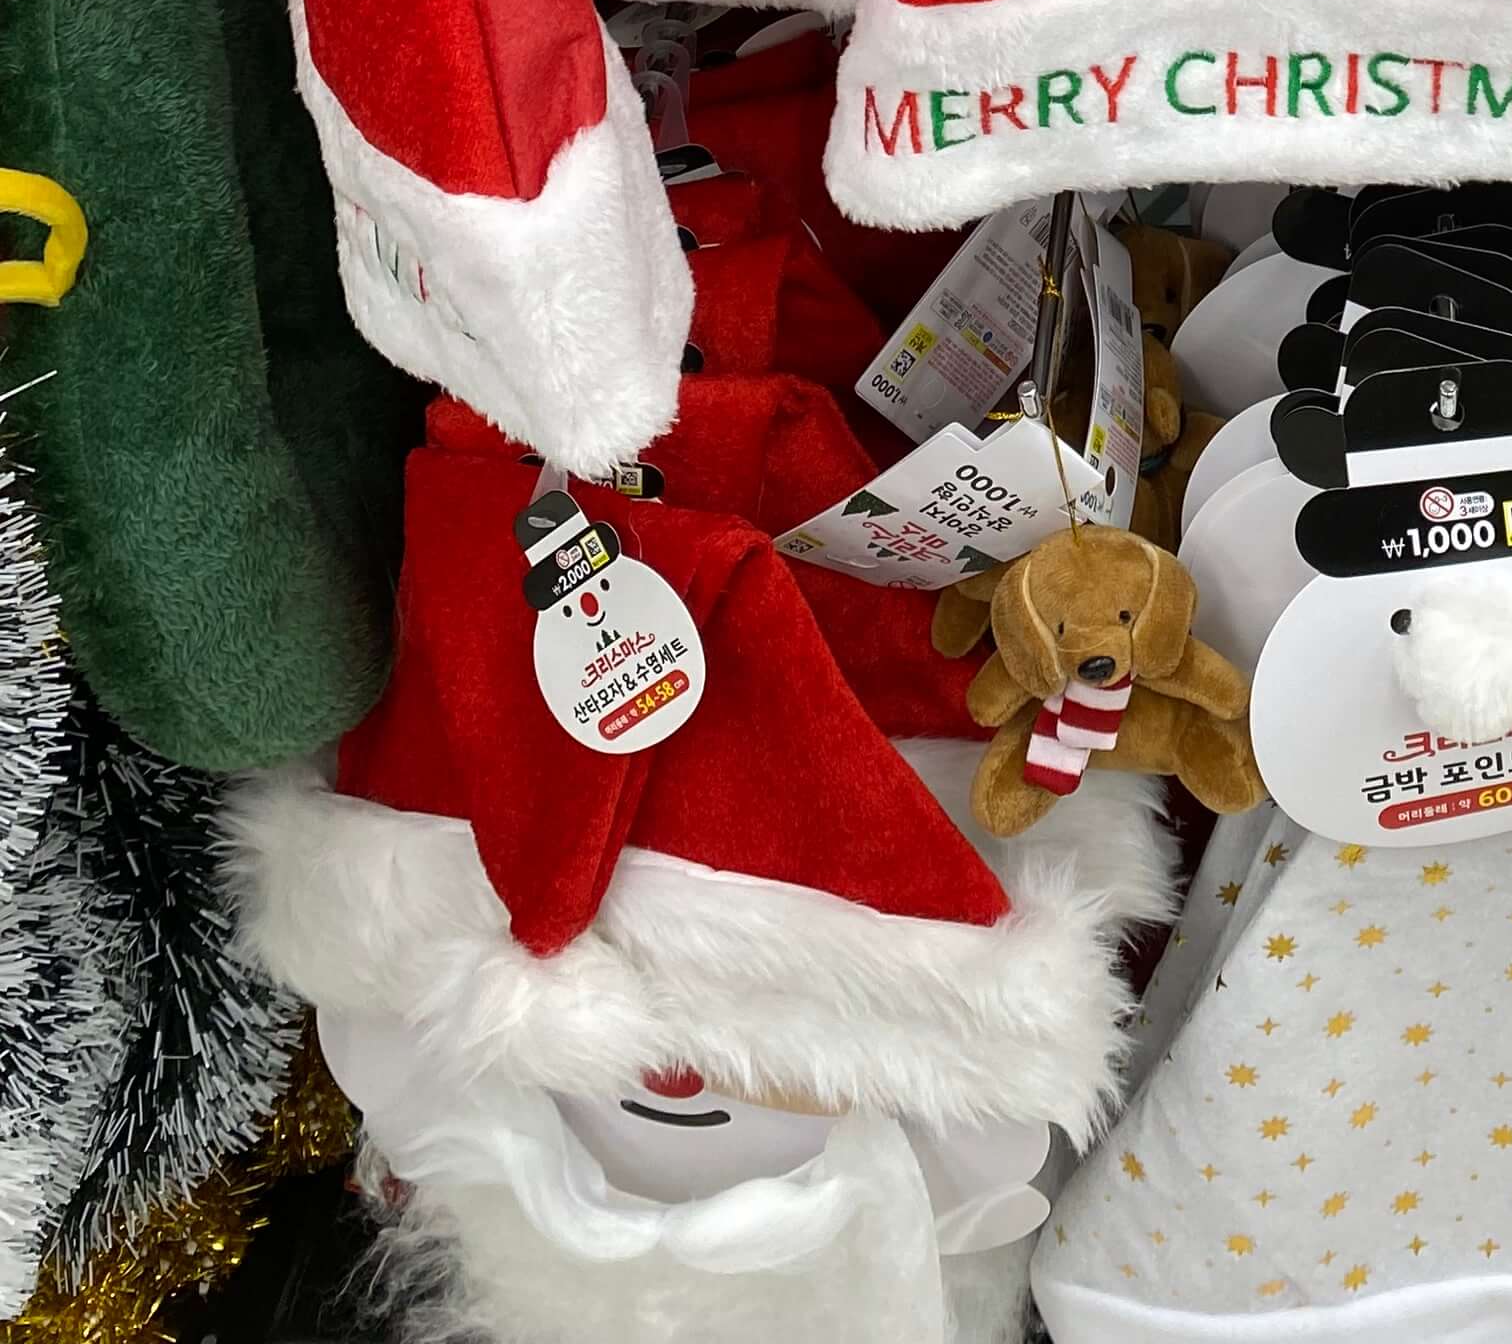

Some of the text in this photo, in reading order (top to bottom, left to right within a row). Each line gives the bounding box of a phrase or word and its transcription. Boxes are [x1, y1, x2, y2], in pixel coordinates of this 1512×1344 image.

[864, 56, 1138, 156] MERRY
[932, 481, 1013, 533] 장식인형
[956, 464, 1038, 519] ₩1,000
[862, 521, 952, 564] 크리스
[900, 521, 949, 549] 마스
[919, 501, 984, 538] 강아지
[1381, 519, 1496, 559] ₩1,000
[581, 631, 656, 689] 크리스마스
[572, 678, 625, 724] 산타모자
[622, 672, 638, 691] &
[1361, 766, 1429, 804] 금박
